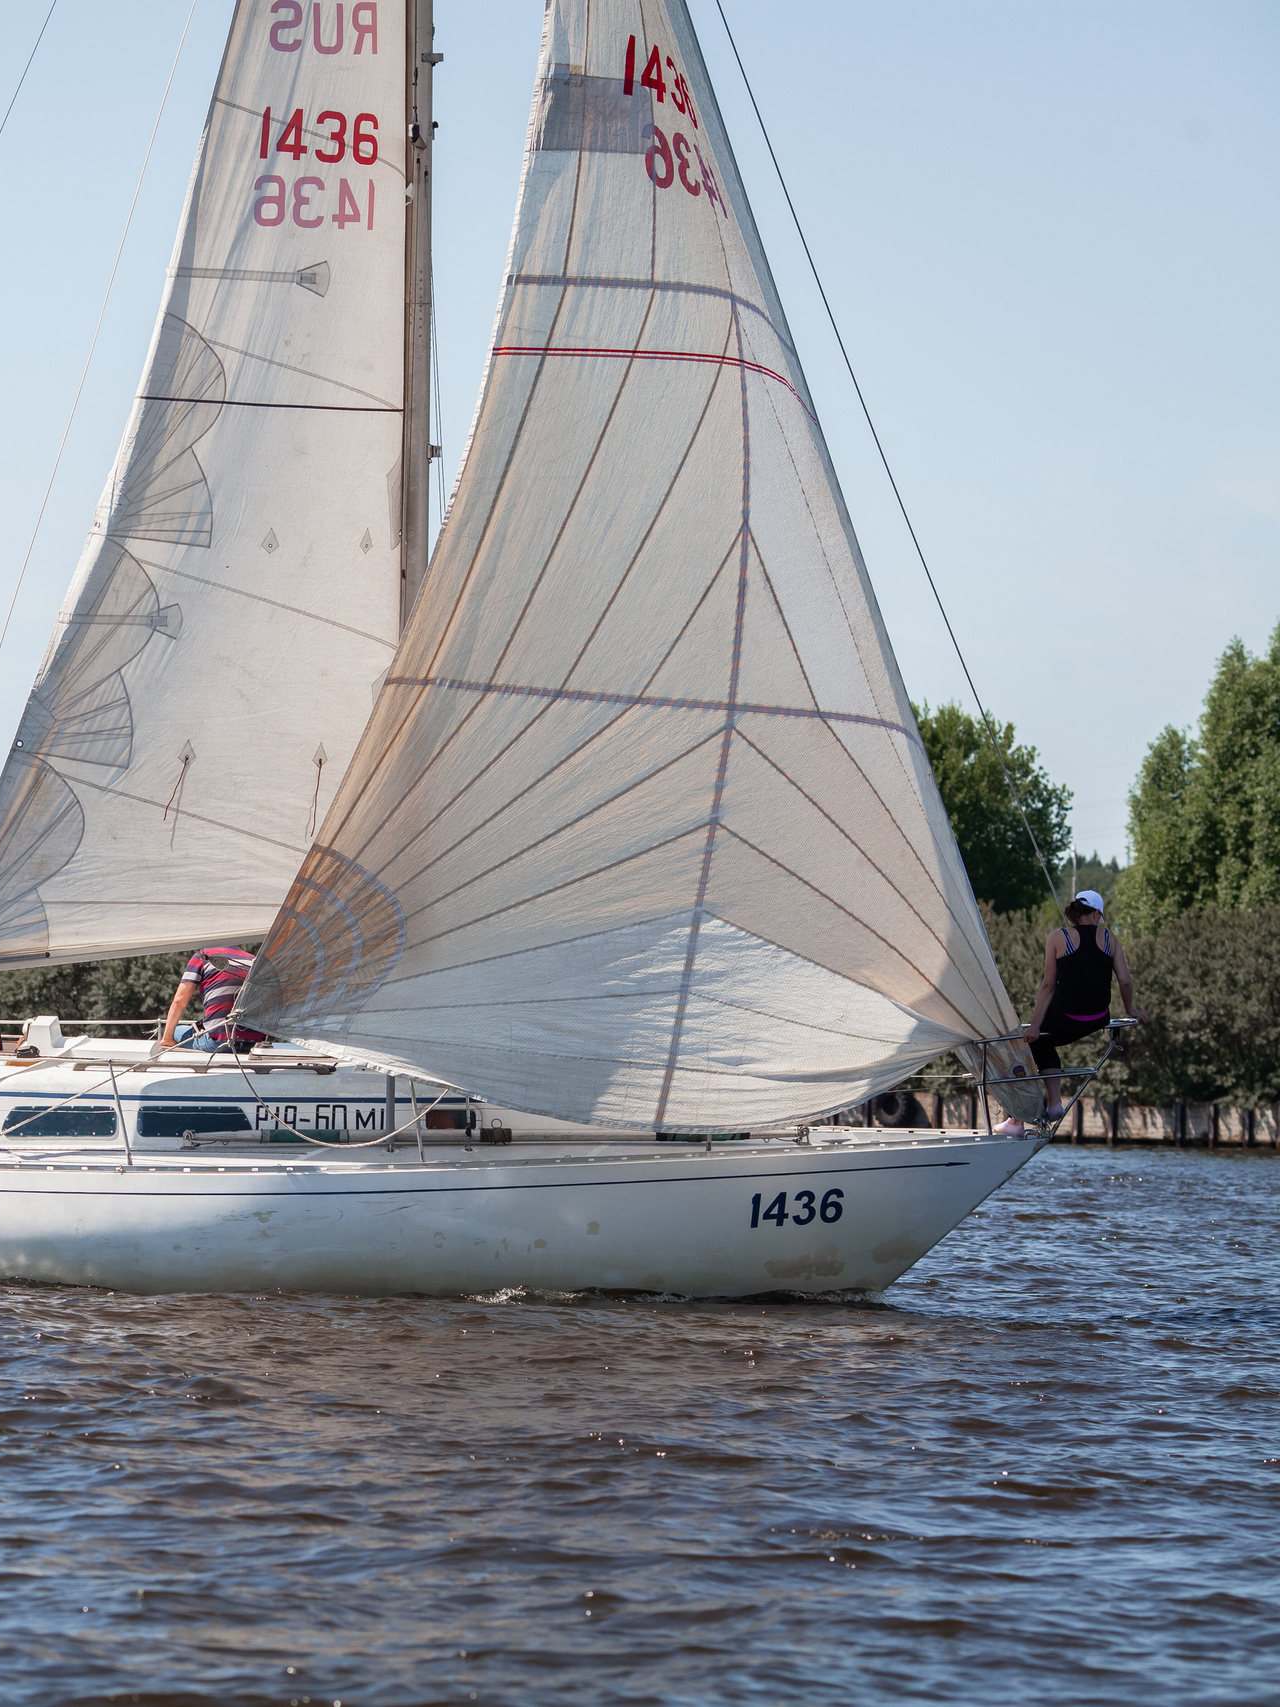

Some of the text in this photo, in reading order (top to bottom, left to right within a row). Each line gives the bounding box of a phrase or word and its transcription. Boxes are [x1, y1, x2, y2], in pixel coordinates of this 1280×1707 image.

[622, 34, 699, 131] 1436
[259, 106, 379, 166] 1436
[750, 1188, 845, 1229] 1436
